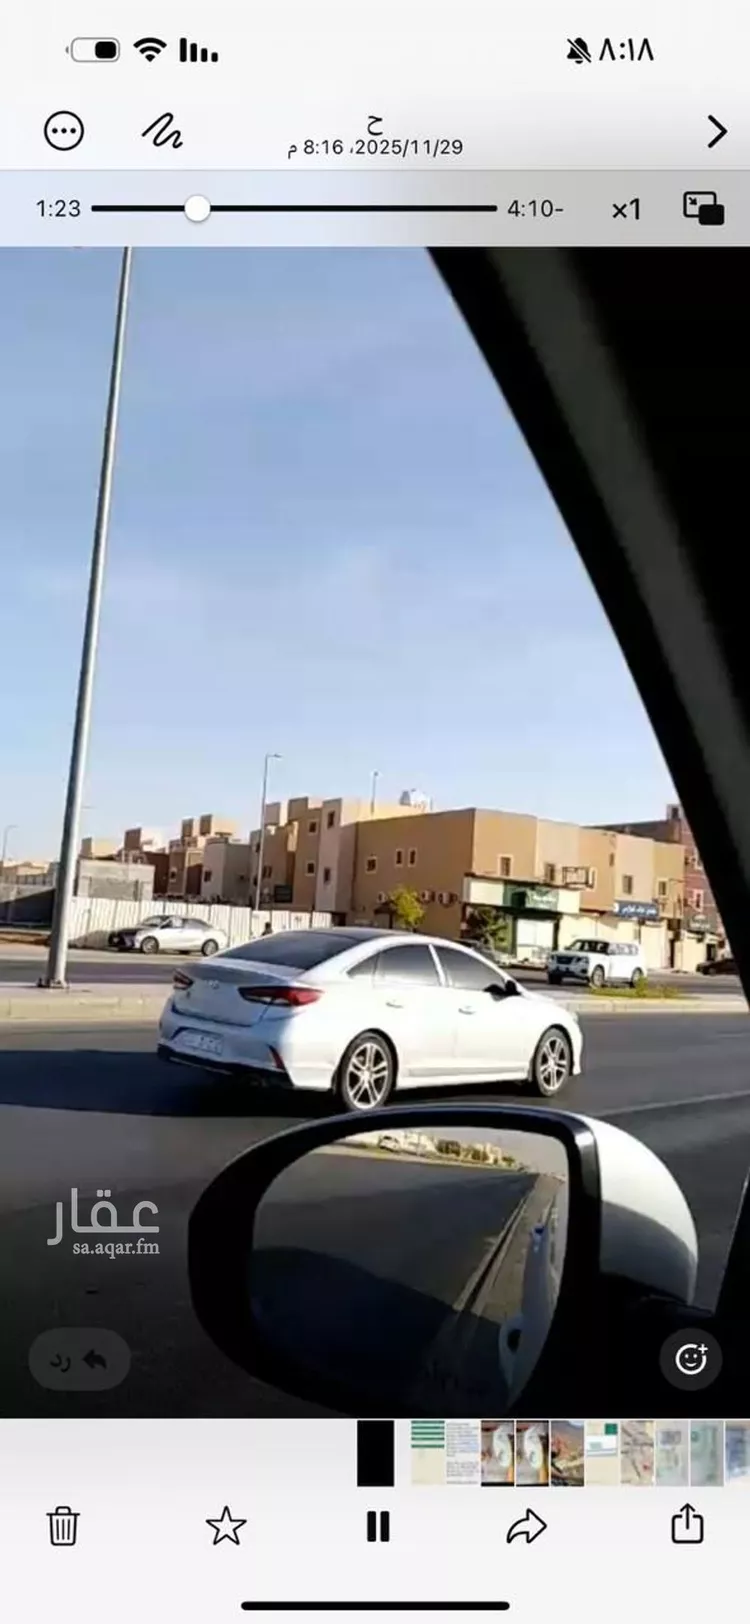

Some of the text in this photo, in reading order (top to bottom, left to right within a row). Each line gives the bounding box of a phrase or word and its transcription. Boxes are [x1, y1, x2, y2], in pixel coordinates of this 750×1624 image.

[287, 144, 298, 159] م
[303, 139, 344, 155] 8:16
[36, 199, 81, 218] 1:23
[49, 1353, 72, 1374] رد
